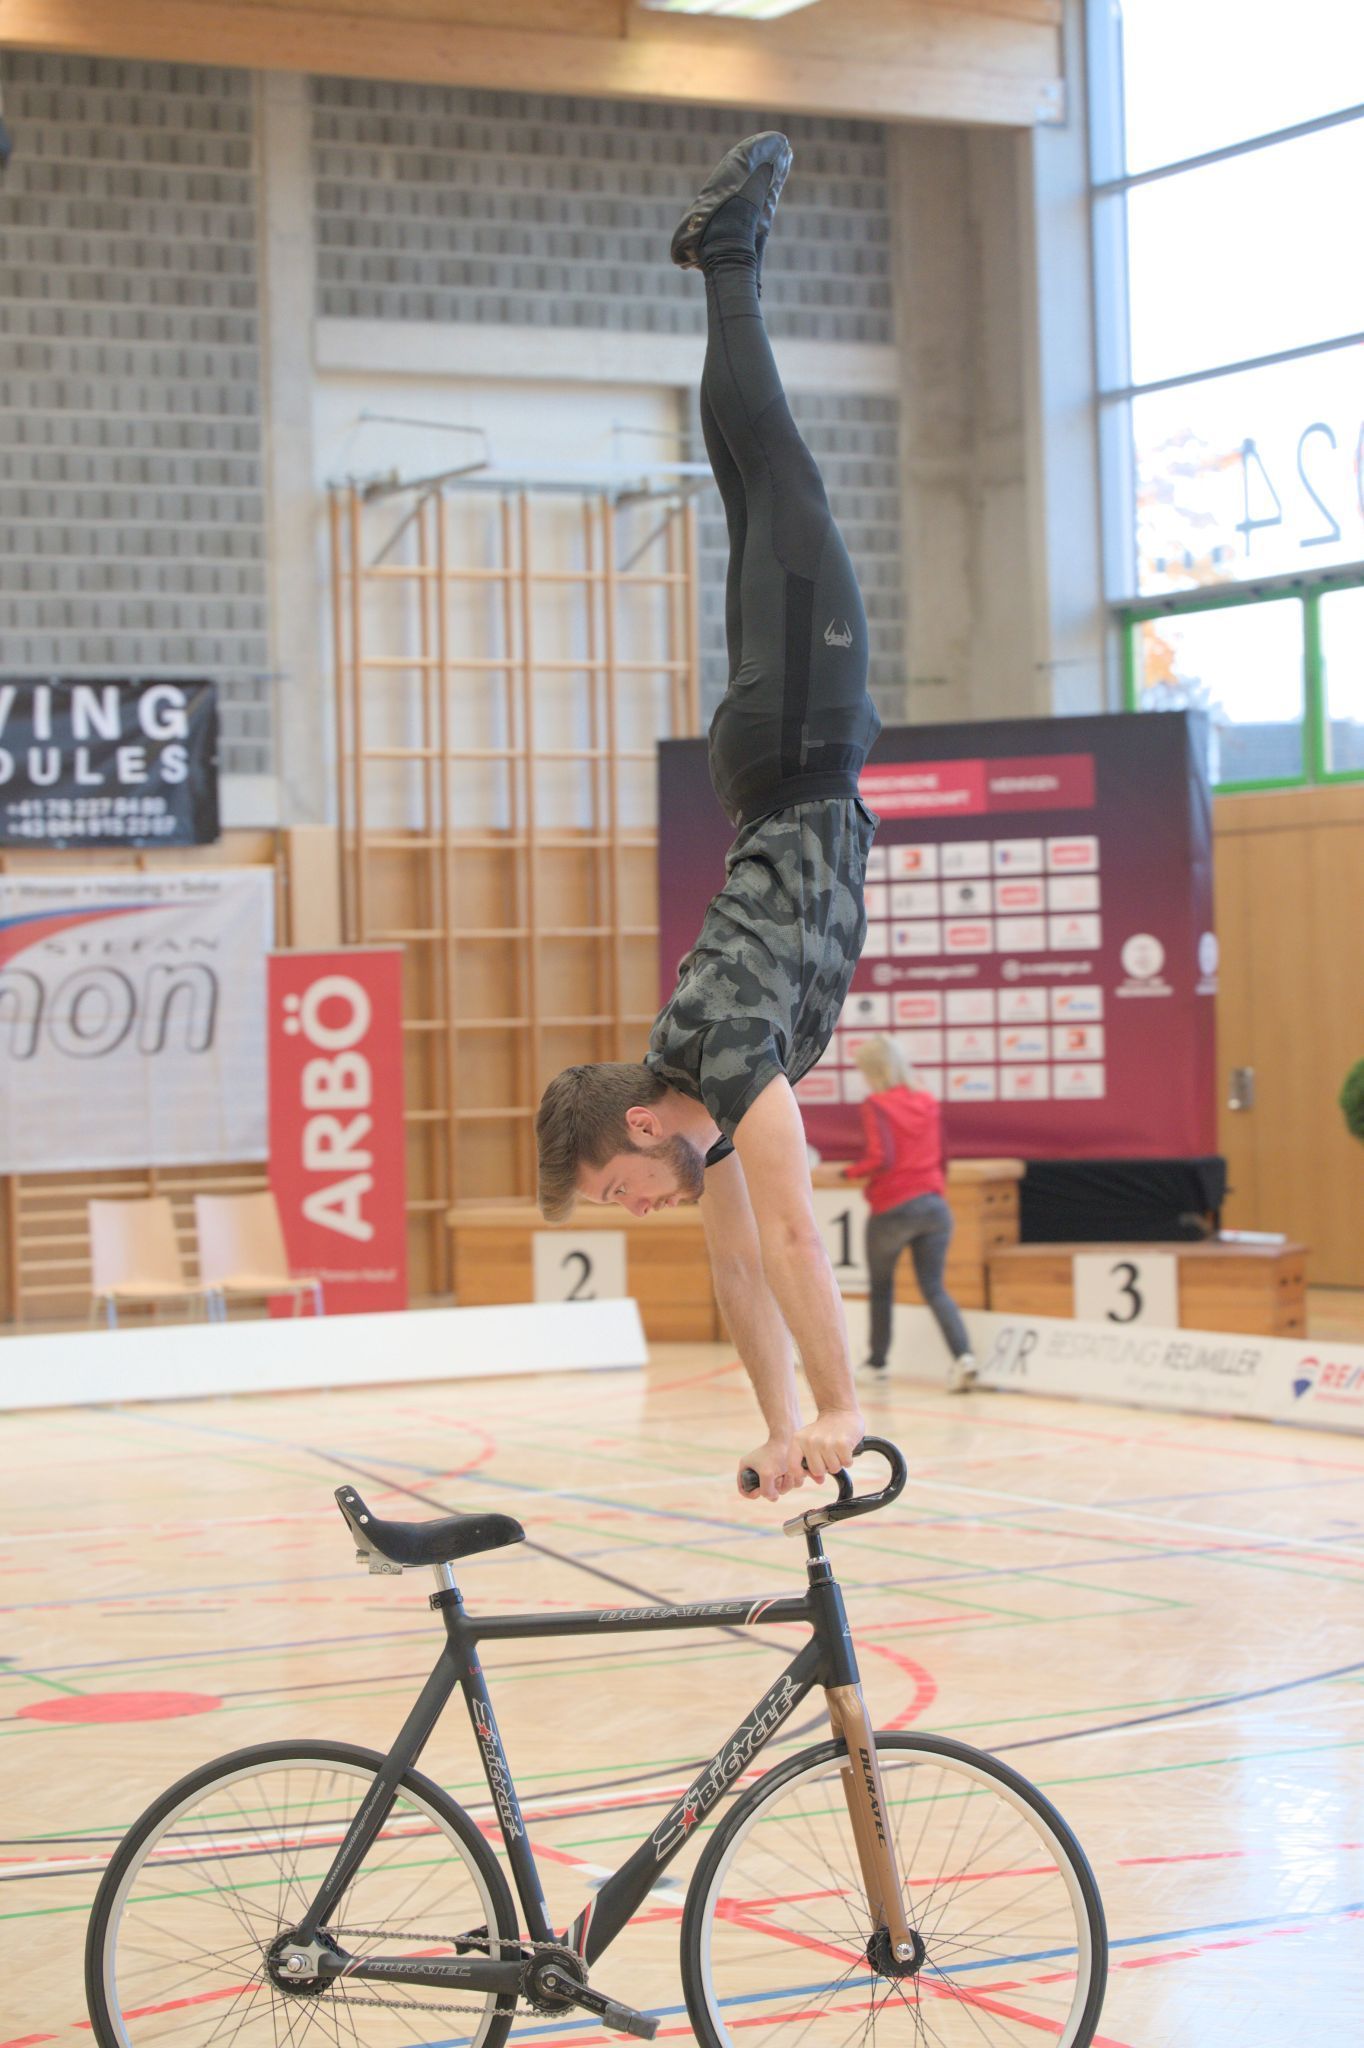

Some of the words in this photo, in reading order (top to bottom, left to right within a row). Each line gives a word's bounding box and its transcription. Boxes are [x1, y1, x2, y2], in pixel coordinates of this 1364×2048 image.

[282, 974, 374, 1243] ARBÖ
[829, 1210, 858, 1269] 1
[561, 1250, 597, 1301] 2
[1105, 1262, 1144, 1324] 3
[1318, 1362, 1364, 1391] RE/
[598, 1603, 743, 1622] DURATEC
[367, 1962, 472, 1977] DURATEC
